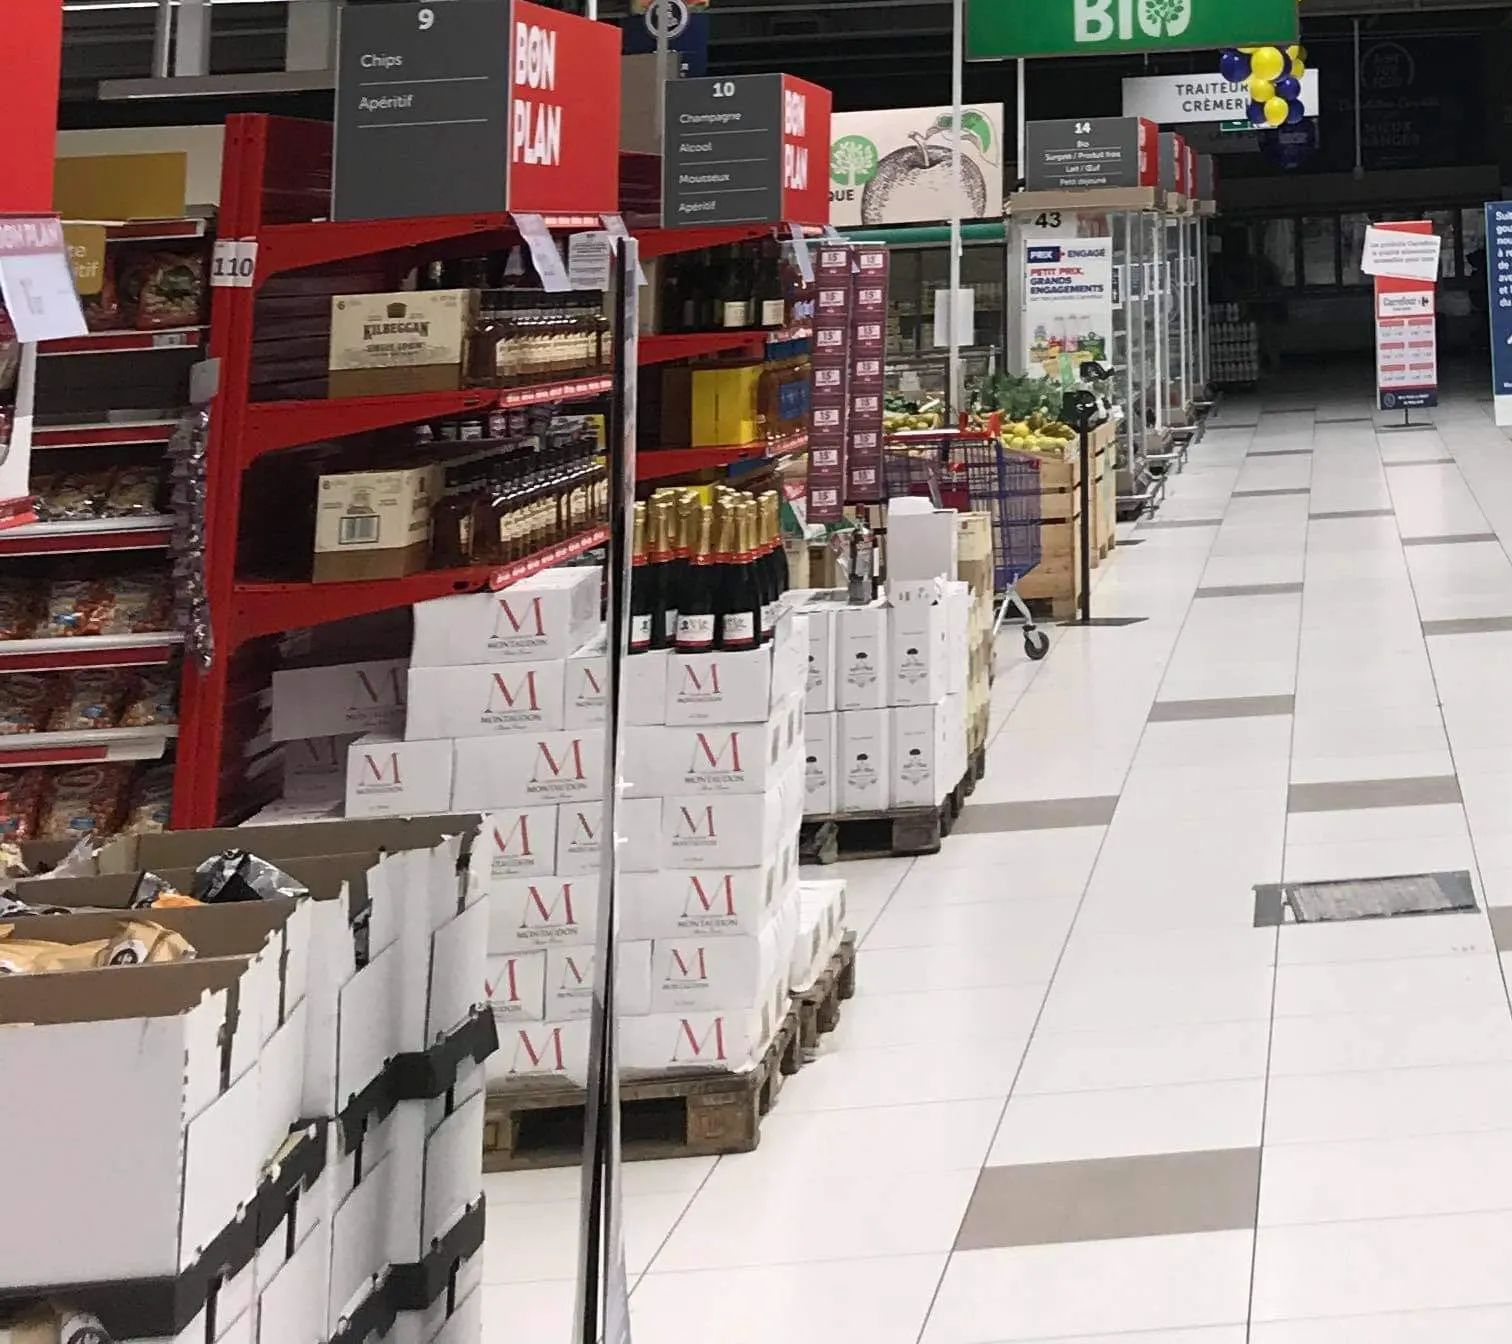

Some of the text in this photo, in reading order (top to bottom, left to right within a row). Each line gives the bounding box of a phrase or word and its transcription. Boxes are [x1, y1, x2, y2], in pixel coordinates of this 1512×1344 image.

[417, 8, 435, 30] 9
[360, 54, 403, 69] Chips
[515, 21, 556, 91] BON
[713, 82, 736, 98] 10
[1175, 81, 1249, 97] TRAITEUR
[358, 94, 414, 112] Apéritif
[1182, 98, 1249, 113] CRÈMERI
[679, 112, 742, 124] Champagne
[513, 99, 563, 166] PLAN
[1074, 122, 1092, 134] 14
[679, 142, 713, 153] Alcool
[784, 143, 808, 190] PLAN
[678, 173, 730, 184] Mousseux
[678, 200, 717, 213] Apéritif
[1035, 211, 1062, 229] 43
[212, 257, 254, 278] 110
[1030, 267, 1057, 277] PETIT
[1498, 261, 1509, 270] de
[1030, 276, 1072, 286] GRANDS
[1030, 283, 1105, 295] ENGAGEMENTS
[1499, 286, 1508, 295] et
[1499, 298, 1512, 307] du
[489, 596, 546, 638] M
[678, 663, 721, 695] M
[483, 670, 541, 713] M
[529, 739, 586, 783] M
[687, 732, 745, 774] M
[358, 752, 402, 786] M
[673, 805, 717, 838] M
[680, 874, 737, 917] M
[518, 883, 578, 929] M
[665, 947, 707, 981] M
[670, 1016, 728, 1062] M
[508, 1027, 566, 1074] M
